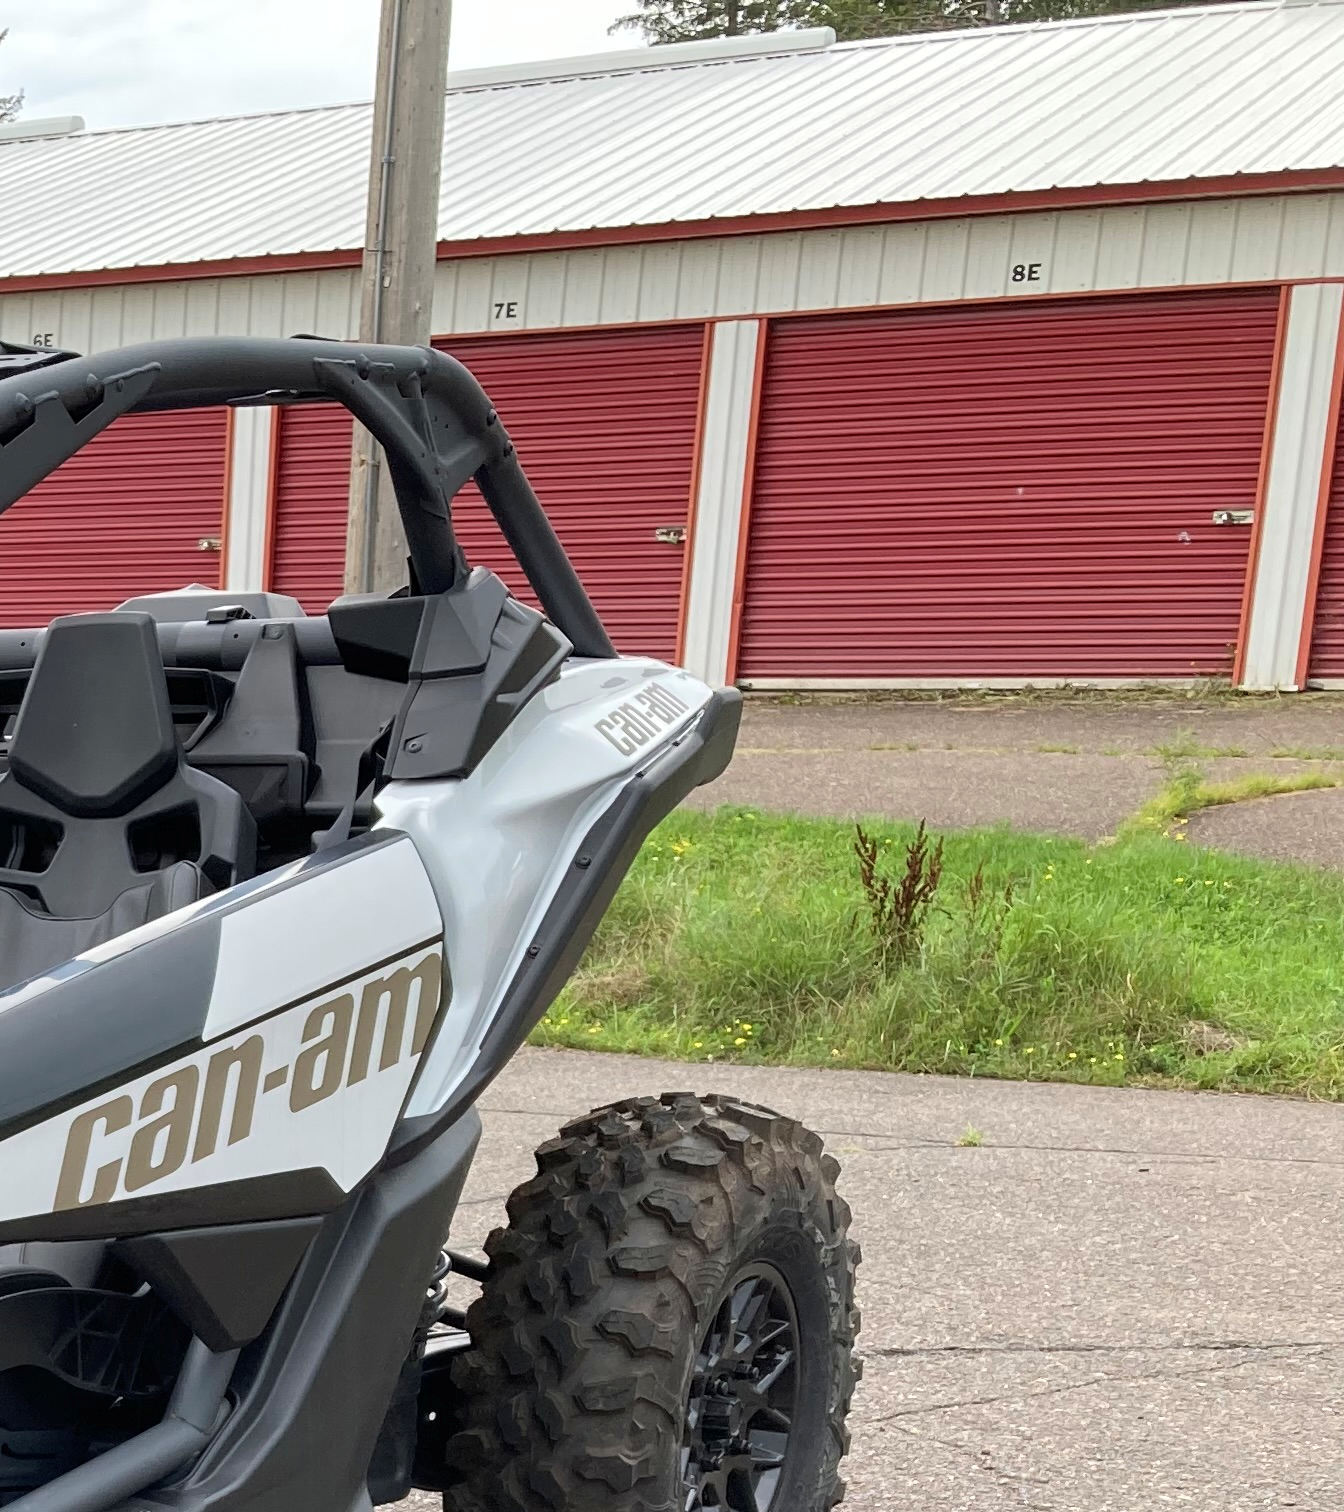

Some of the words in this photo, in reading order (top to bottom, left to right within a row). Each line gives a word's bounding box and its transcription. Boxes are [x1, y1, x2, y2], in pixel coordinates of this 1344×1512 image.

[1011, 263, 1042, 282] 8E
[494, 302, 518, 319] 7E
[33, 333, 54, 347] 6E
